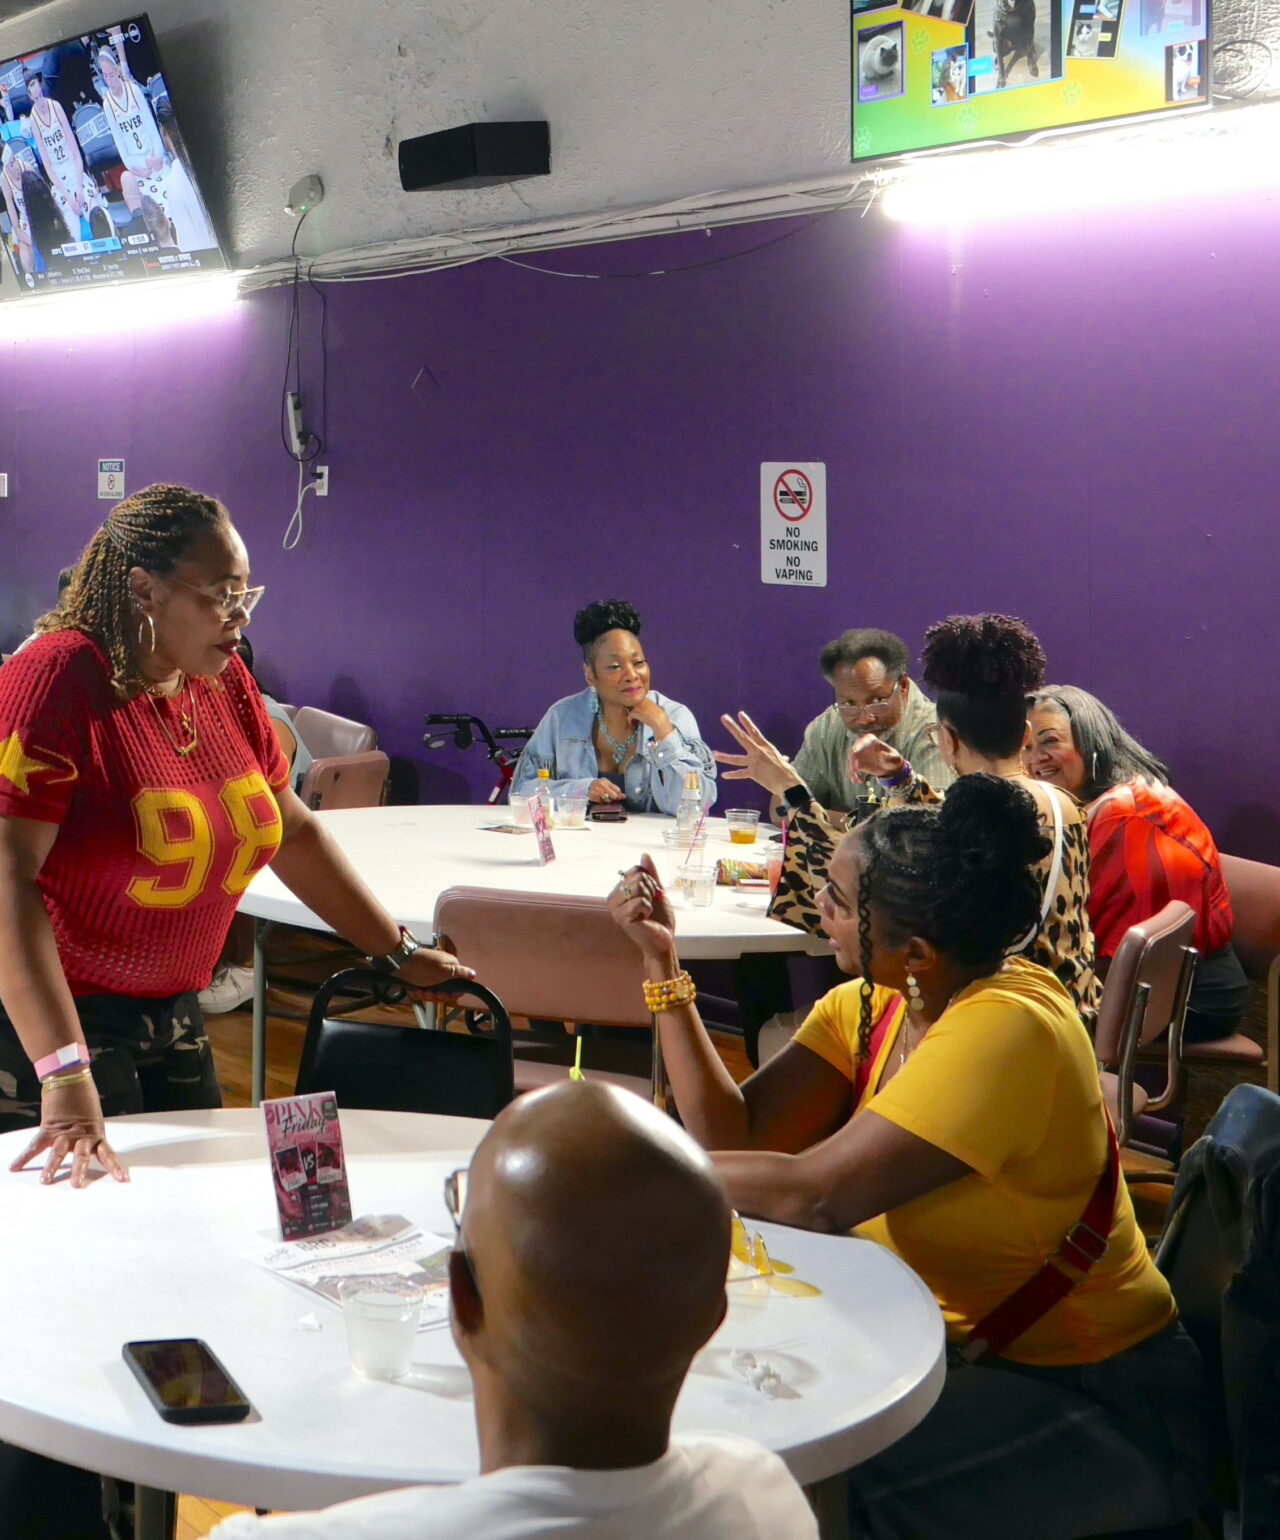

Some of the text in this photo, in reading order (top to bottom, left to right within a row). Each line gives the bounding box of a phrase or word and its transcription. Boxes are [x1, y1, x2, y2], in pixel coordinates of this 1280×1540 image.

[119, 114, 144, 133] FEVER
[43, 129, 64, 147] FEVER
[132, 131, 142, 150] 8
[53, 146, 66, 162] 22
[102, 462, 121, 472] NOTICE
[785, 526, 801, 538] NO
[769, 538, 819, 552] SMOKING
[785, 555, 801, 568] NO
[775, 568, 813, 581] VAPING
[125, 770, 283, 910] 98
[274, 1100, 324, 1126] PINK
[281, 1111, 328, 1139] Friday
[303, 1153, 315, 1171] VS
